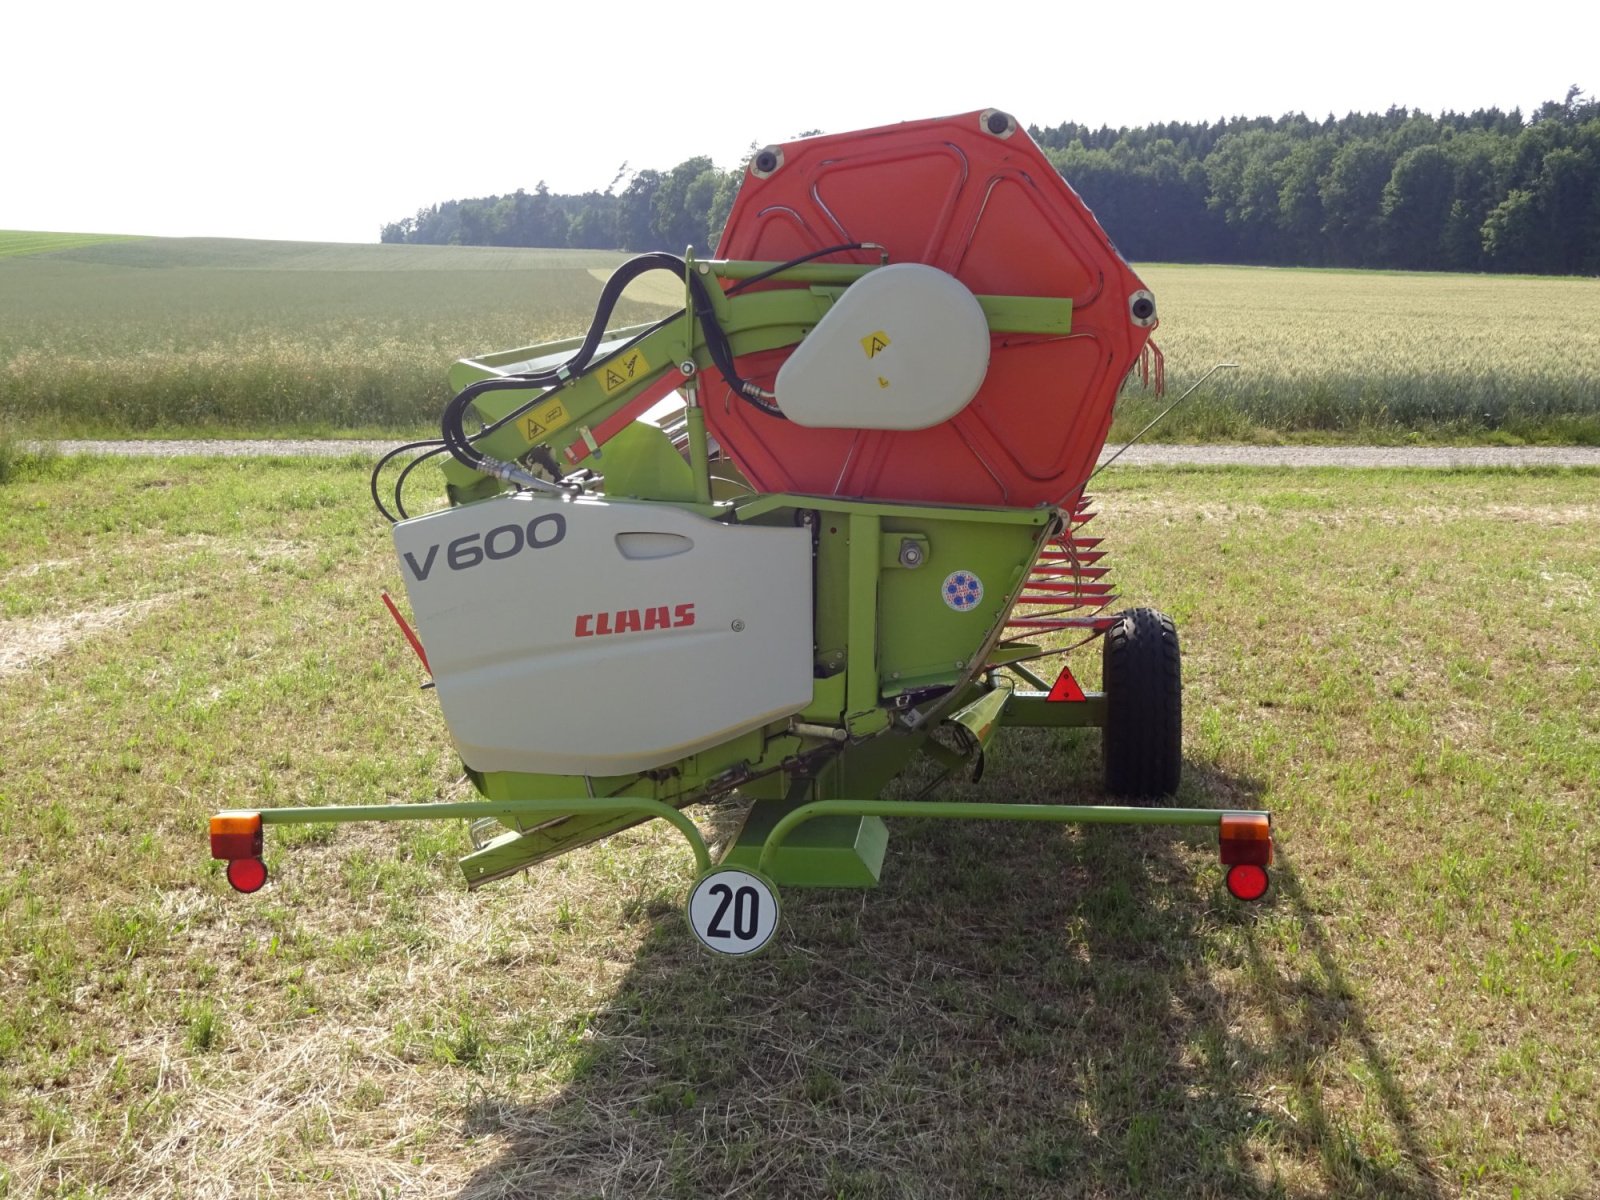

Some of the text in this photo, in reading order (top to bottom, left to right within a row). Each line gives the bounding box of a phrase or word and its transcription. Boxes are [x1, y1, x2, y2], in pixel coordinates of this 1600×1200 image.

[403, 513, 567, 581] V600
[575, 603, 696, 638] CLAAS
[707, 883, 760, 940] 20
